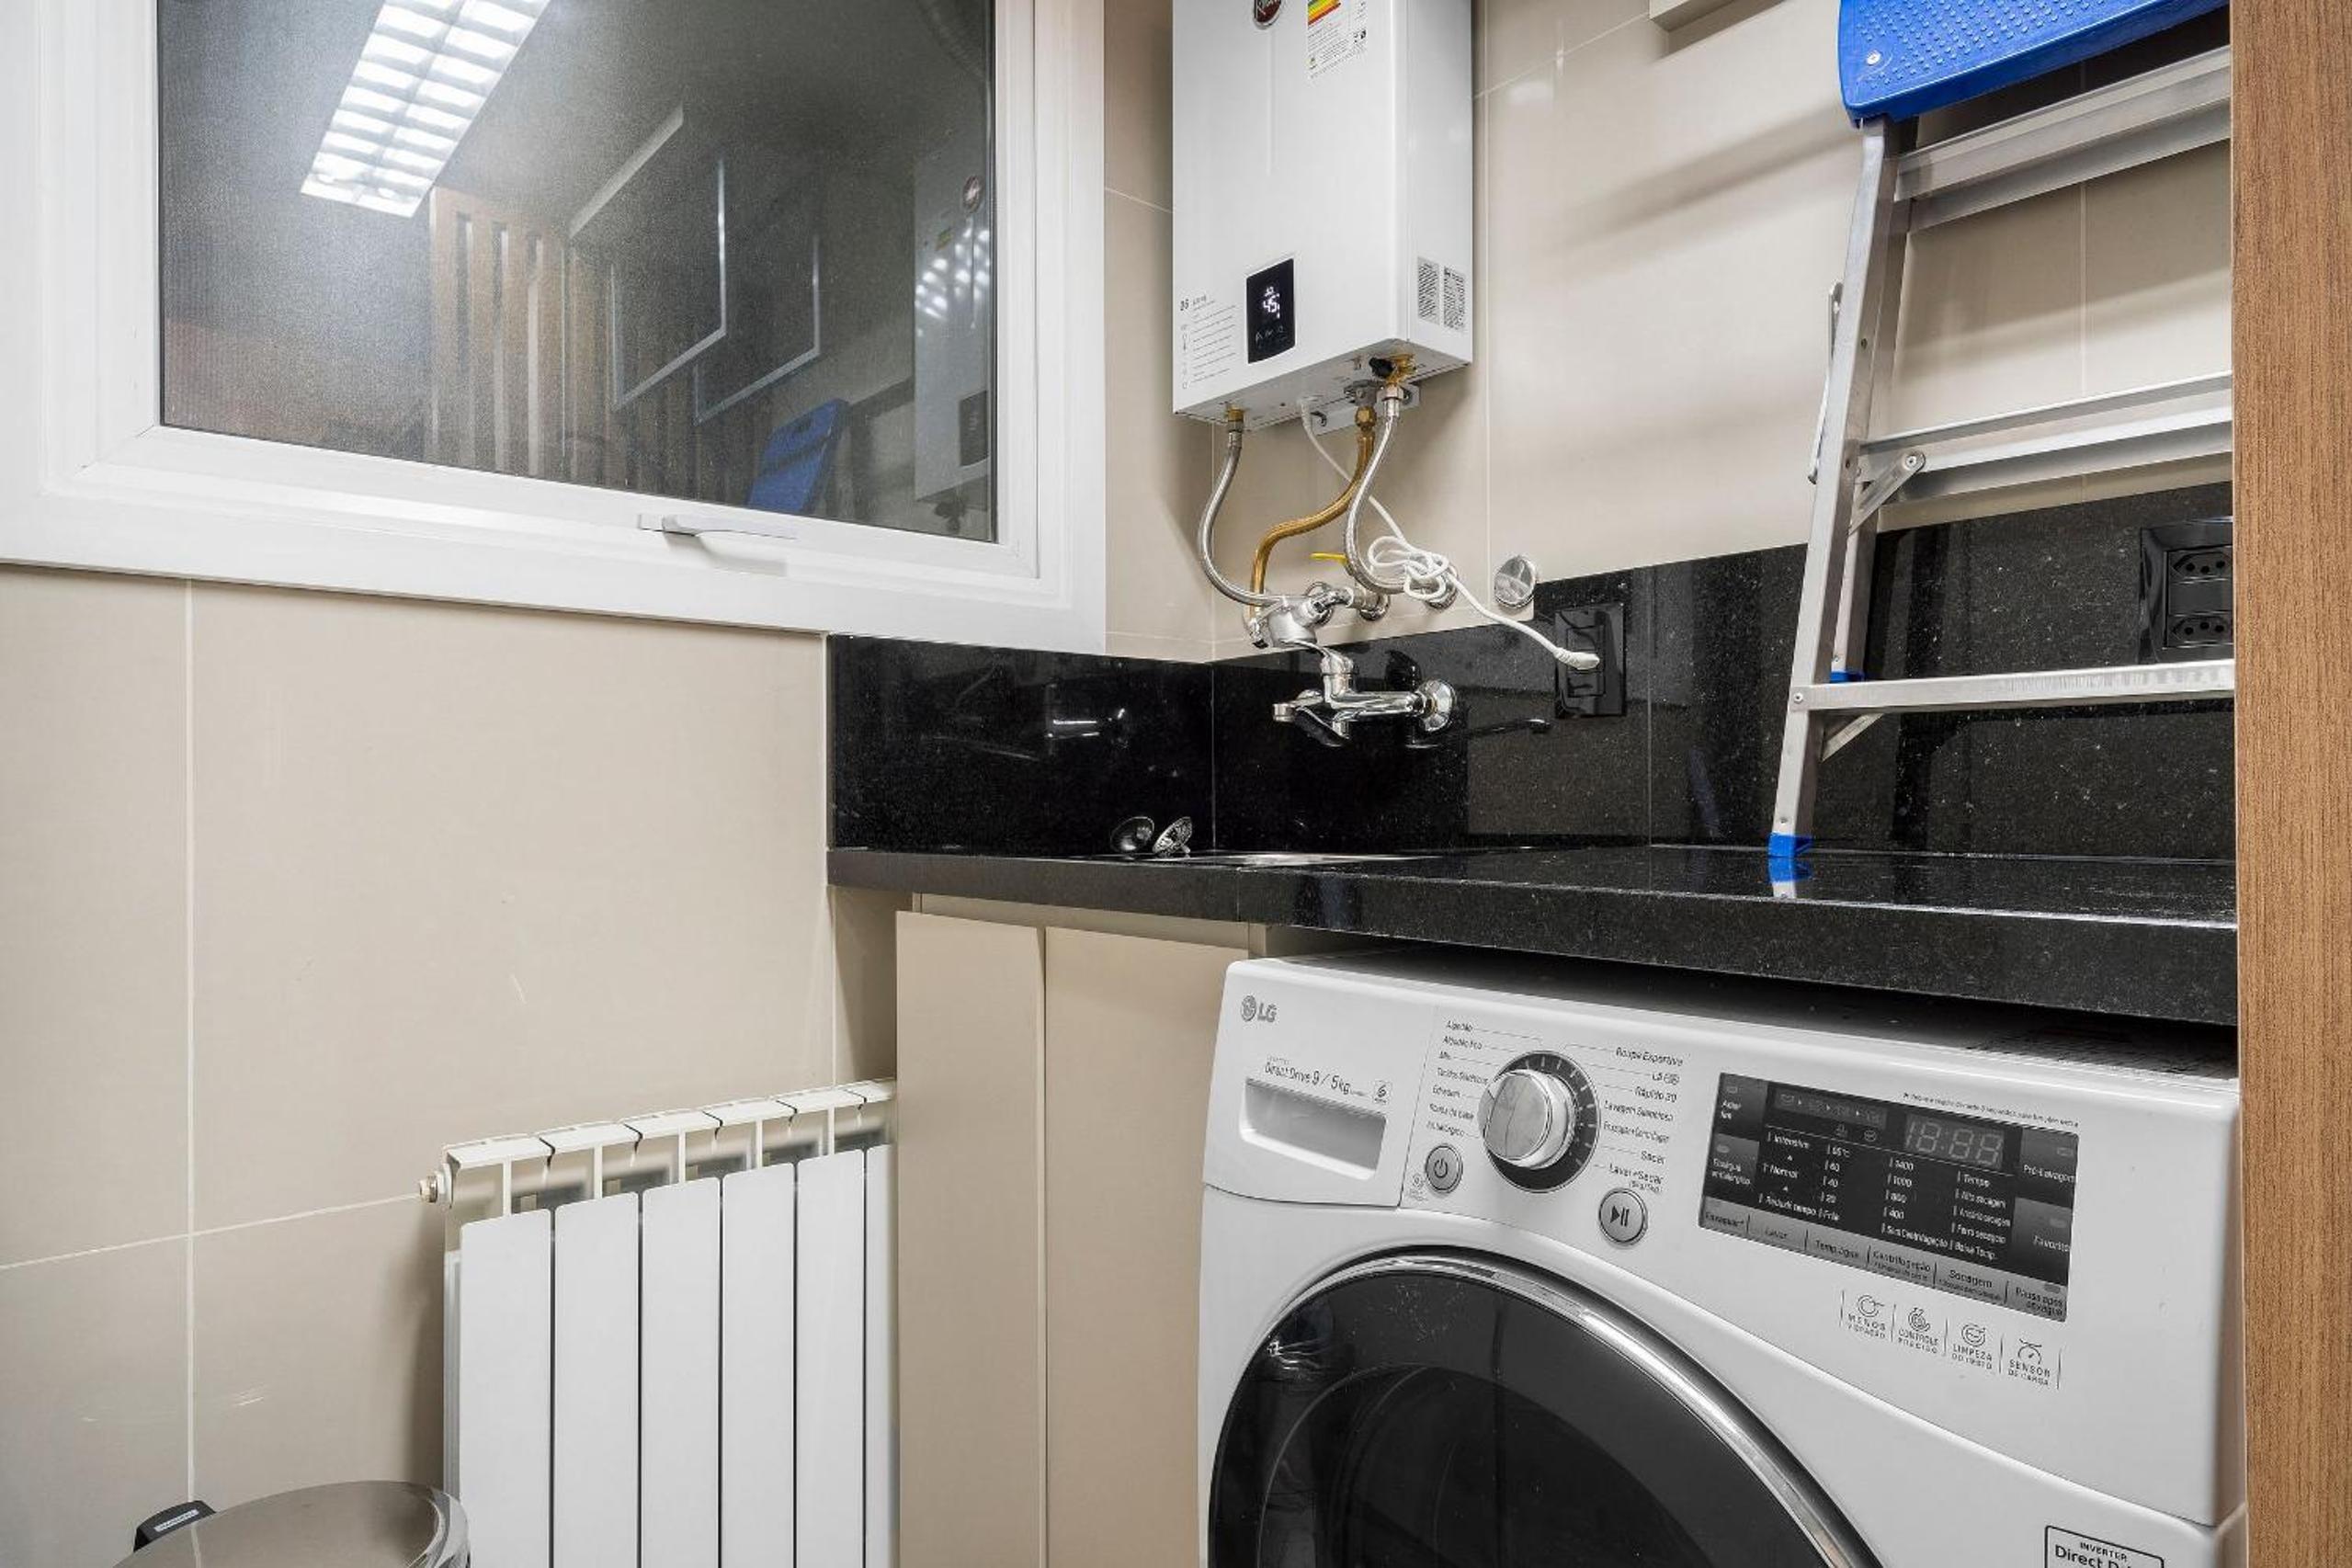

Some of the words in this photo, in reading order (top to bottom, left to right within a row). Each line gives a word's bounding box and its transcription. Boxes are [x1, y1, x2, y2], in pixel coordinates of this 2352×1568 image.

[1290, 1067, 1311, 1084] Drive
[1312, 1071, 1320, 1085] 9
[1331, 1075, 1351, 1095] 5kg
[1642, 1150, 1665, 1165] Secar
[1847, 1313, 1886, 1331] MENOS
[1898, 1328, 1939, 1346] CONTROLE
[1952, 1344, 1993, 1361] LIMPEZA
[2009, 1359, 2051, 1378] SENSOR
[2055, 1544, 2104, 1568] Direct
[2080, 1542, 2128, 1562] INVERTER
